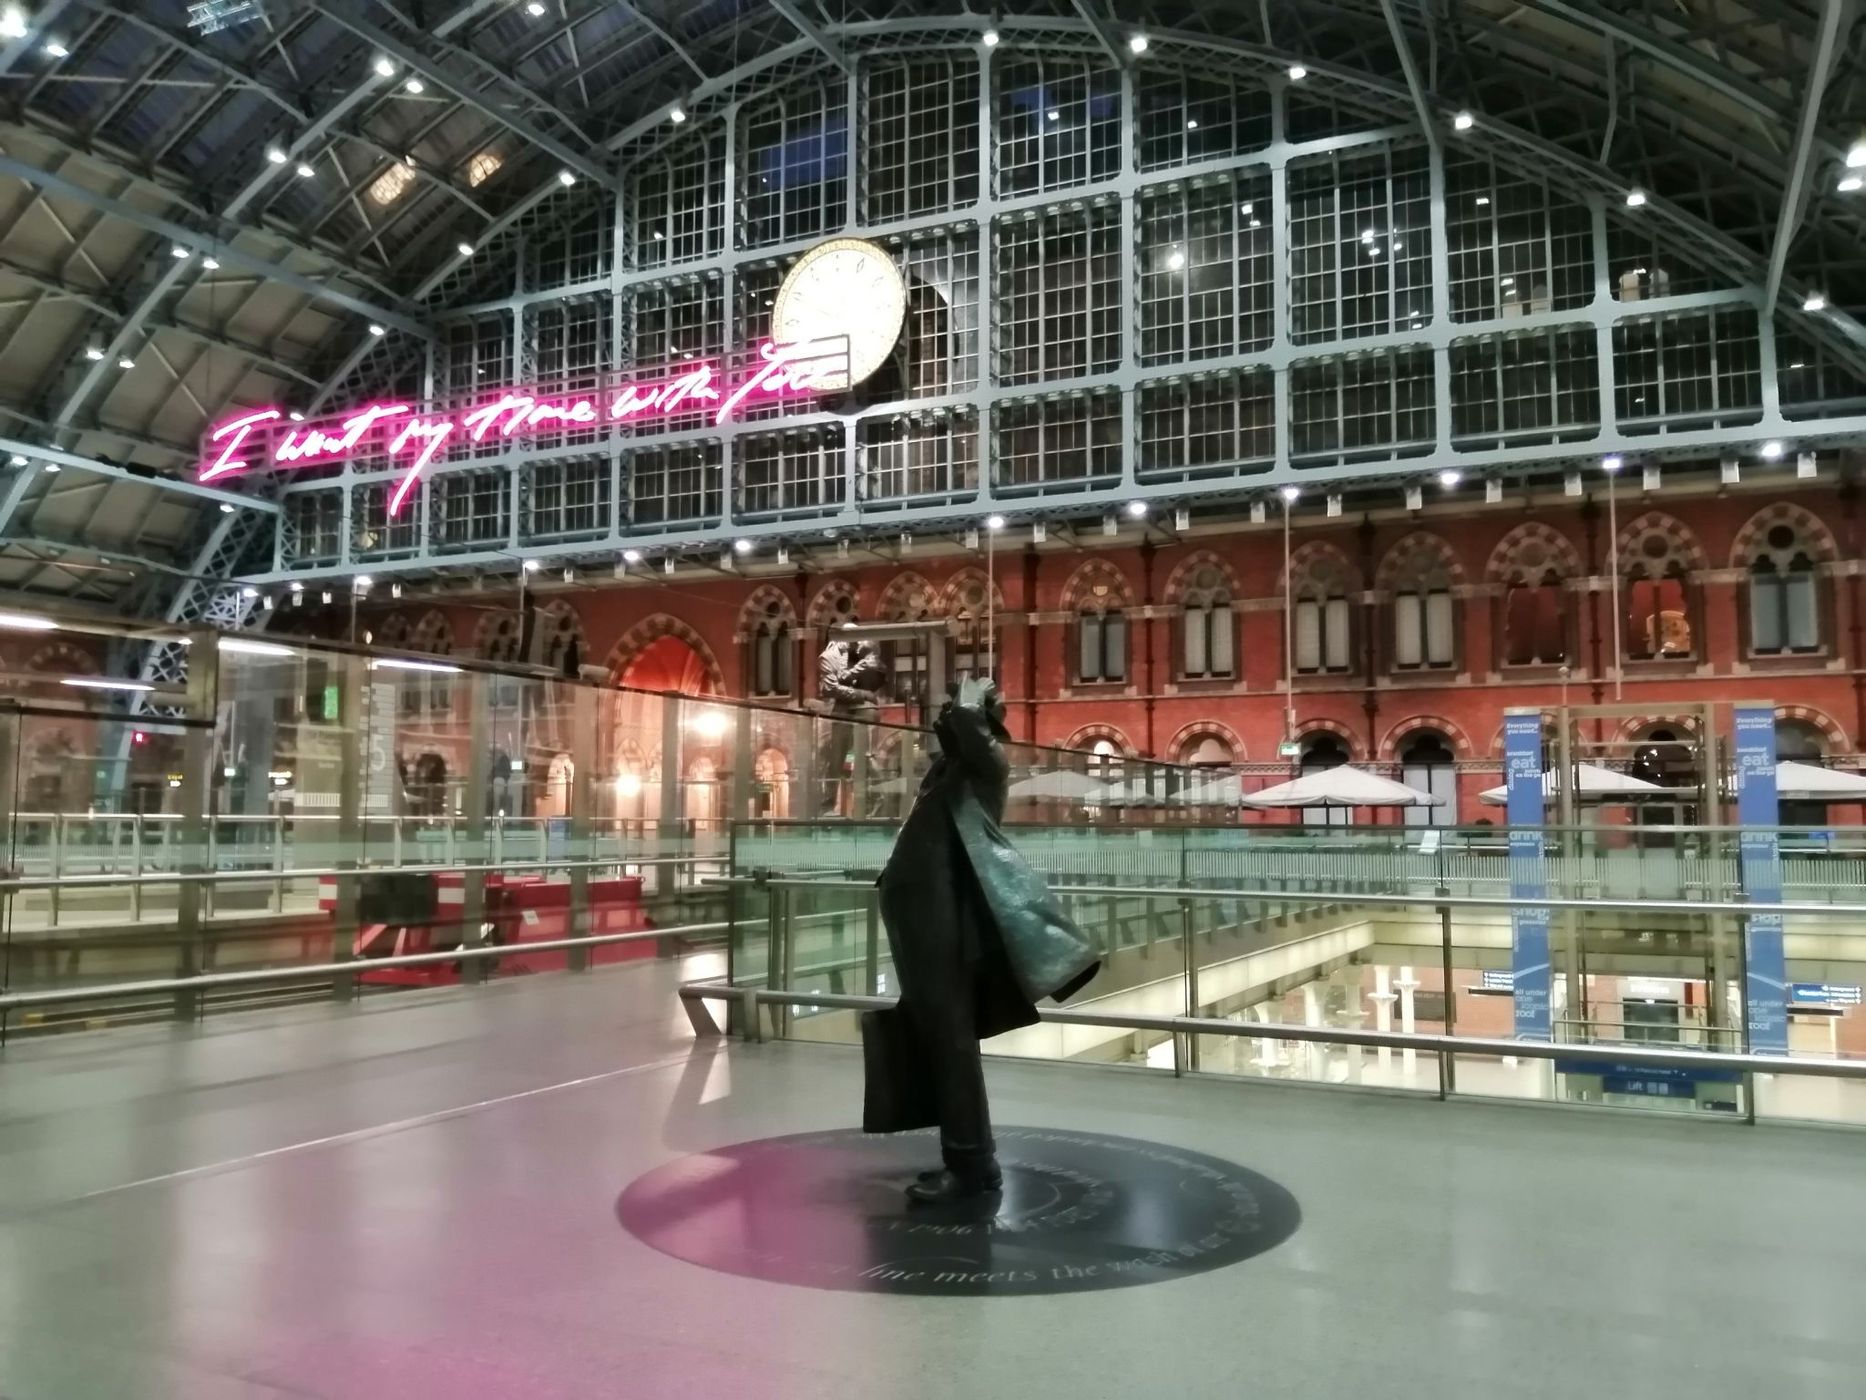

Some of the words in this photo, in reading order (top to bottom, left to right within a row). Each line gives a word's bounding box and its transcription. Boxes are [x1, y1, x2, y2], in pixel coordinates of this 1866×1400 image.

[199, 410, 281, 482] I
[275, 405, 409, 461] want
[389, 418, 454, 516] my
[370, 734, 386, 772] 5
[1511, 756, 1536, 768] eat
[1742, 752, 1769, 766] eat
[933, 1268, 1037, 1282] meets
[1053, 1261, 1099, 1279] the
